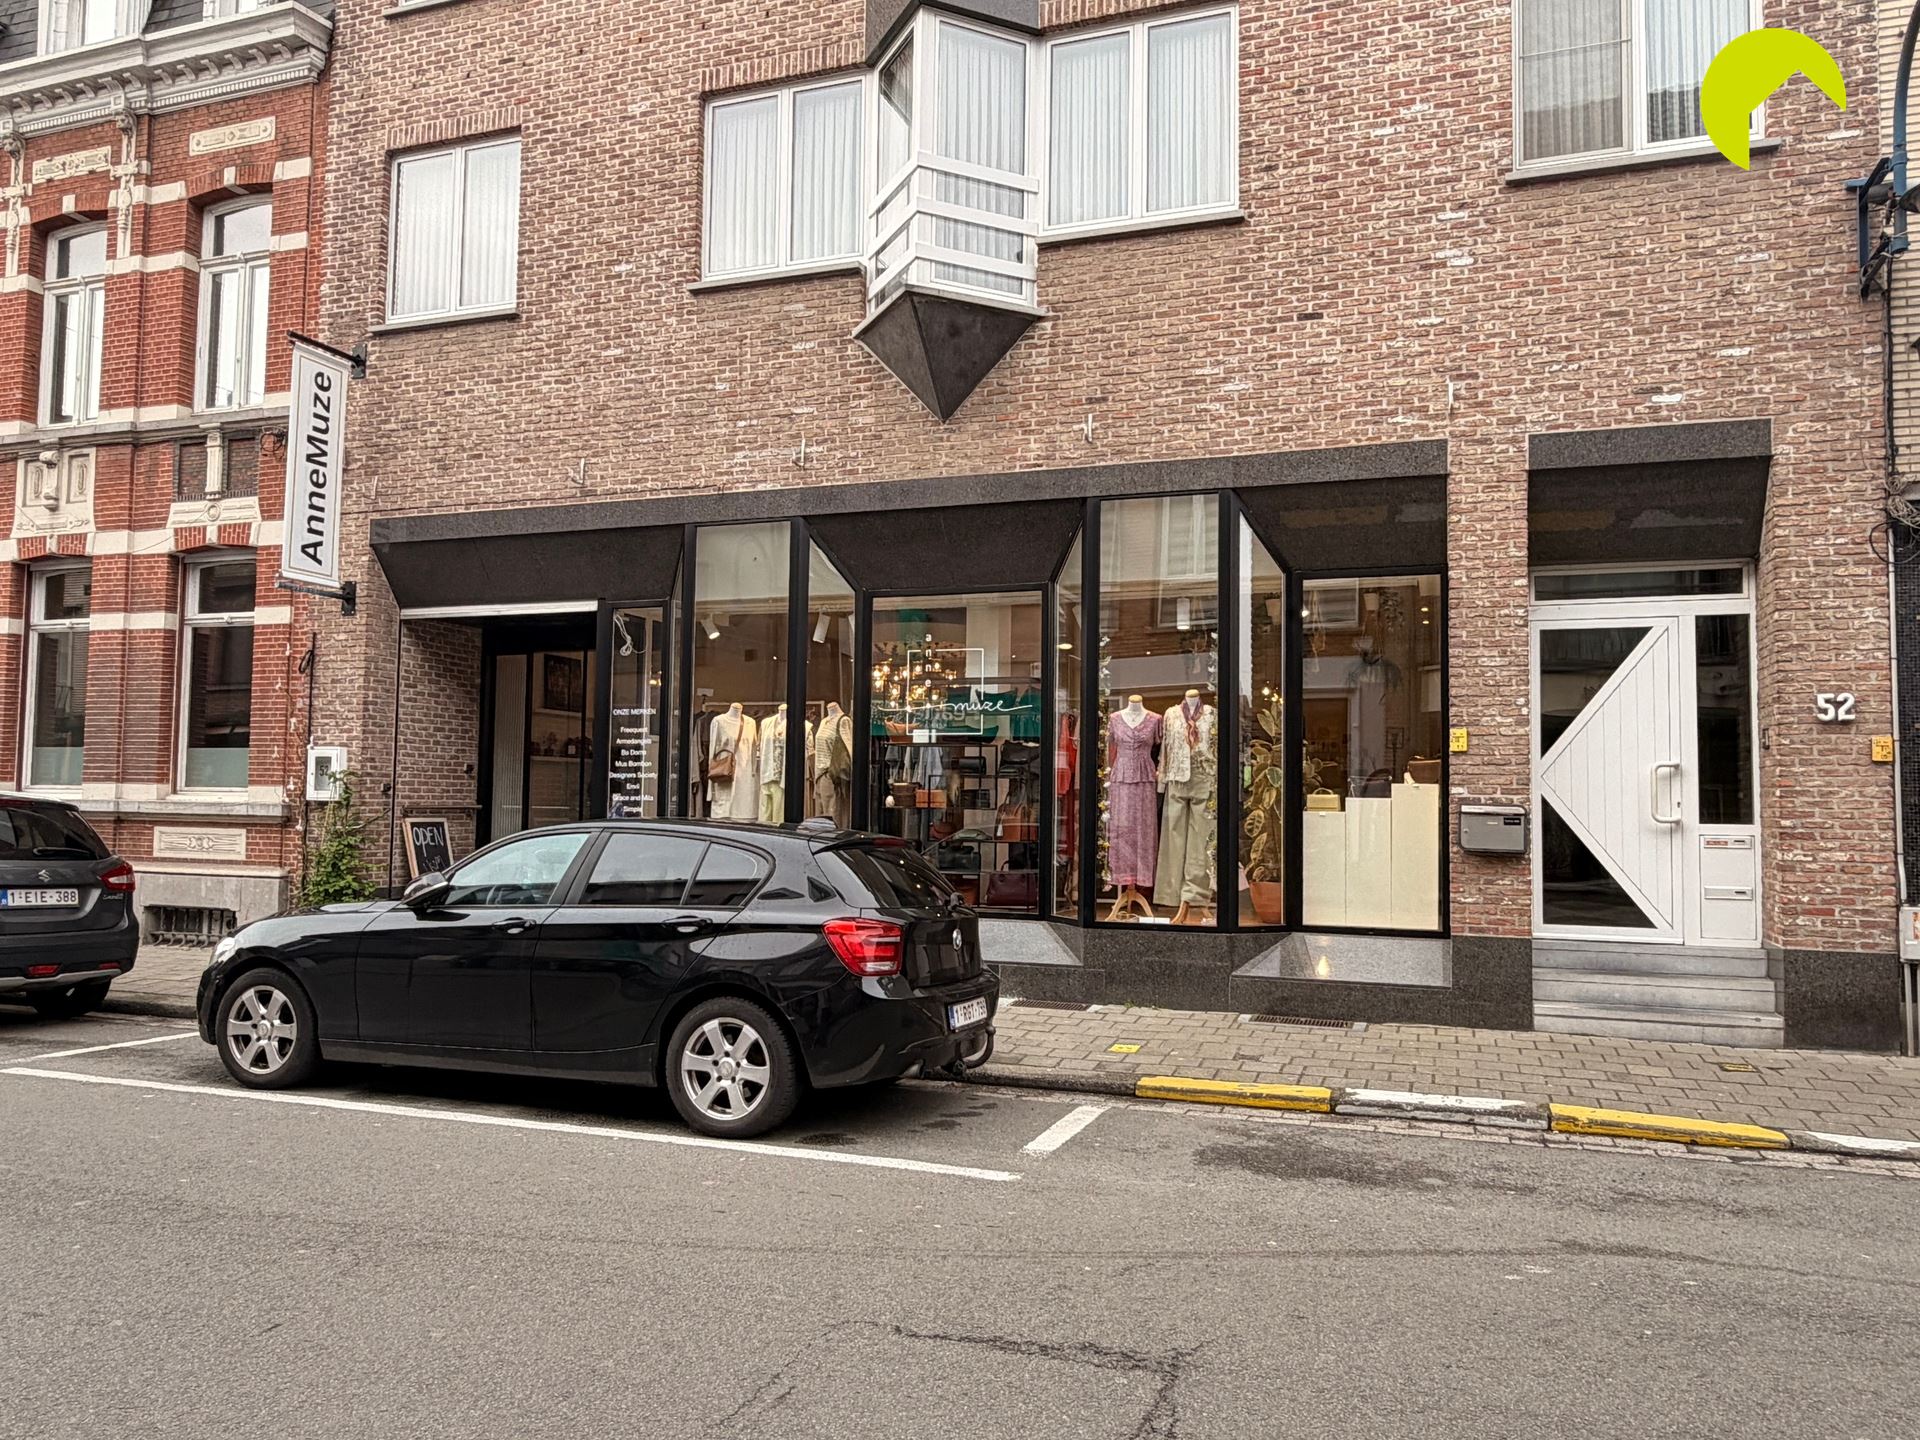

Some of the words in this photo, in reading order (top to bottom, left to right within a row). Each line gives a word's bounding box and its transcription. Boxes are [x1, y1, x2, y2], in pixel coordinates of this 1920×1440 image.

[300, 371, 332, 566] AnneMuze
[613, 708, 630, 716] ONZE
[1815, 692, 1856, 721] 52
[412, 826, 444, 857] OPEN
[9, 890, 77, 904] 1-EIE-388
